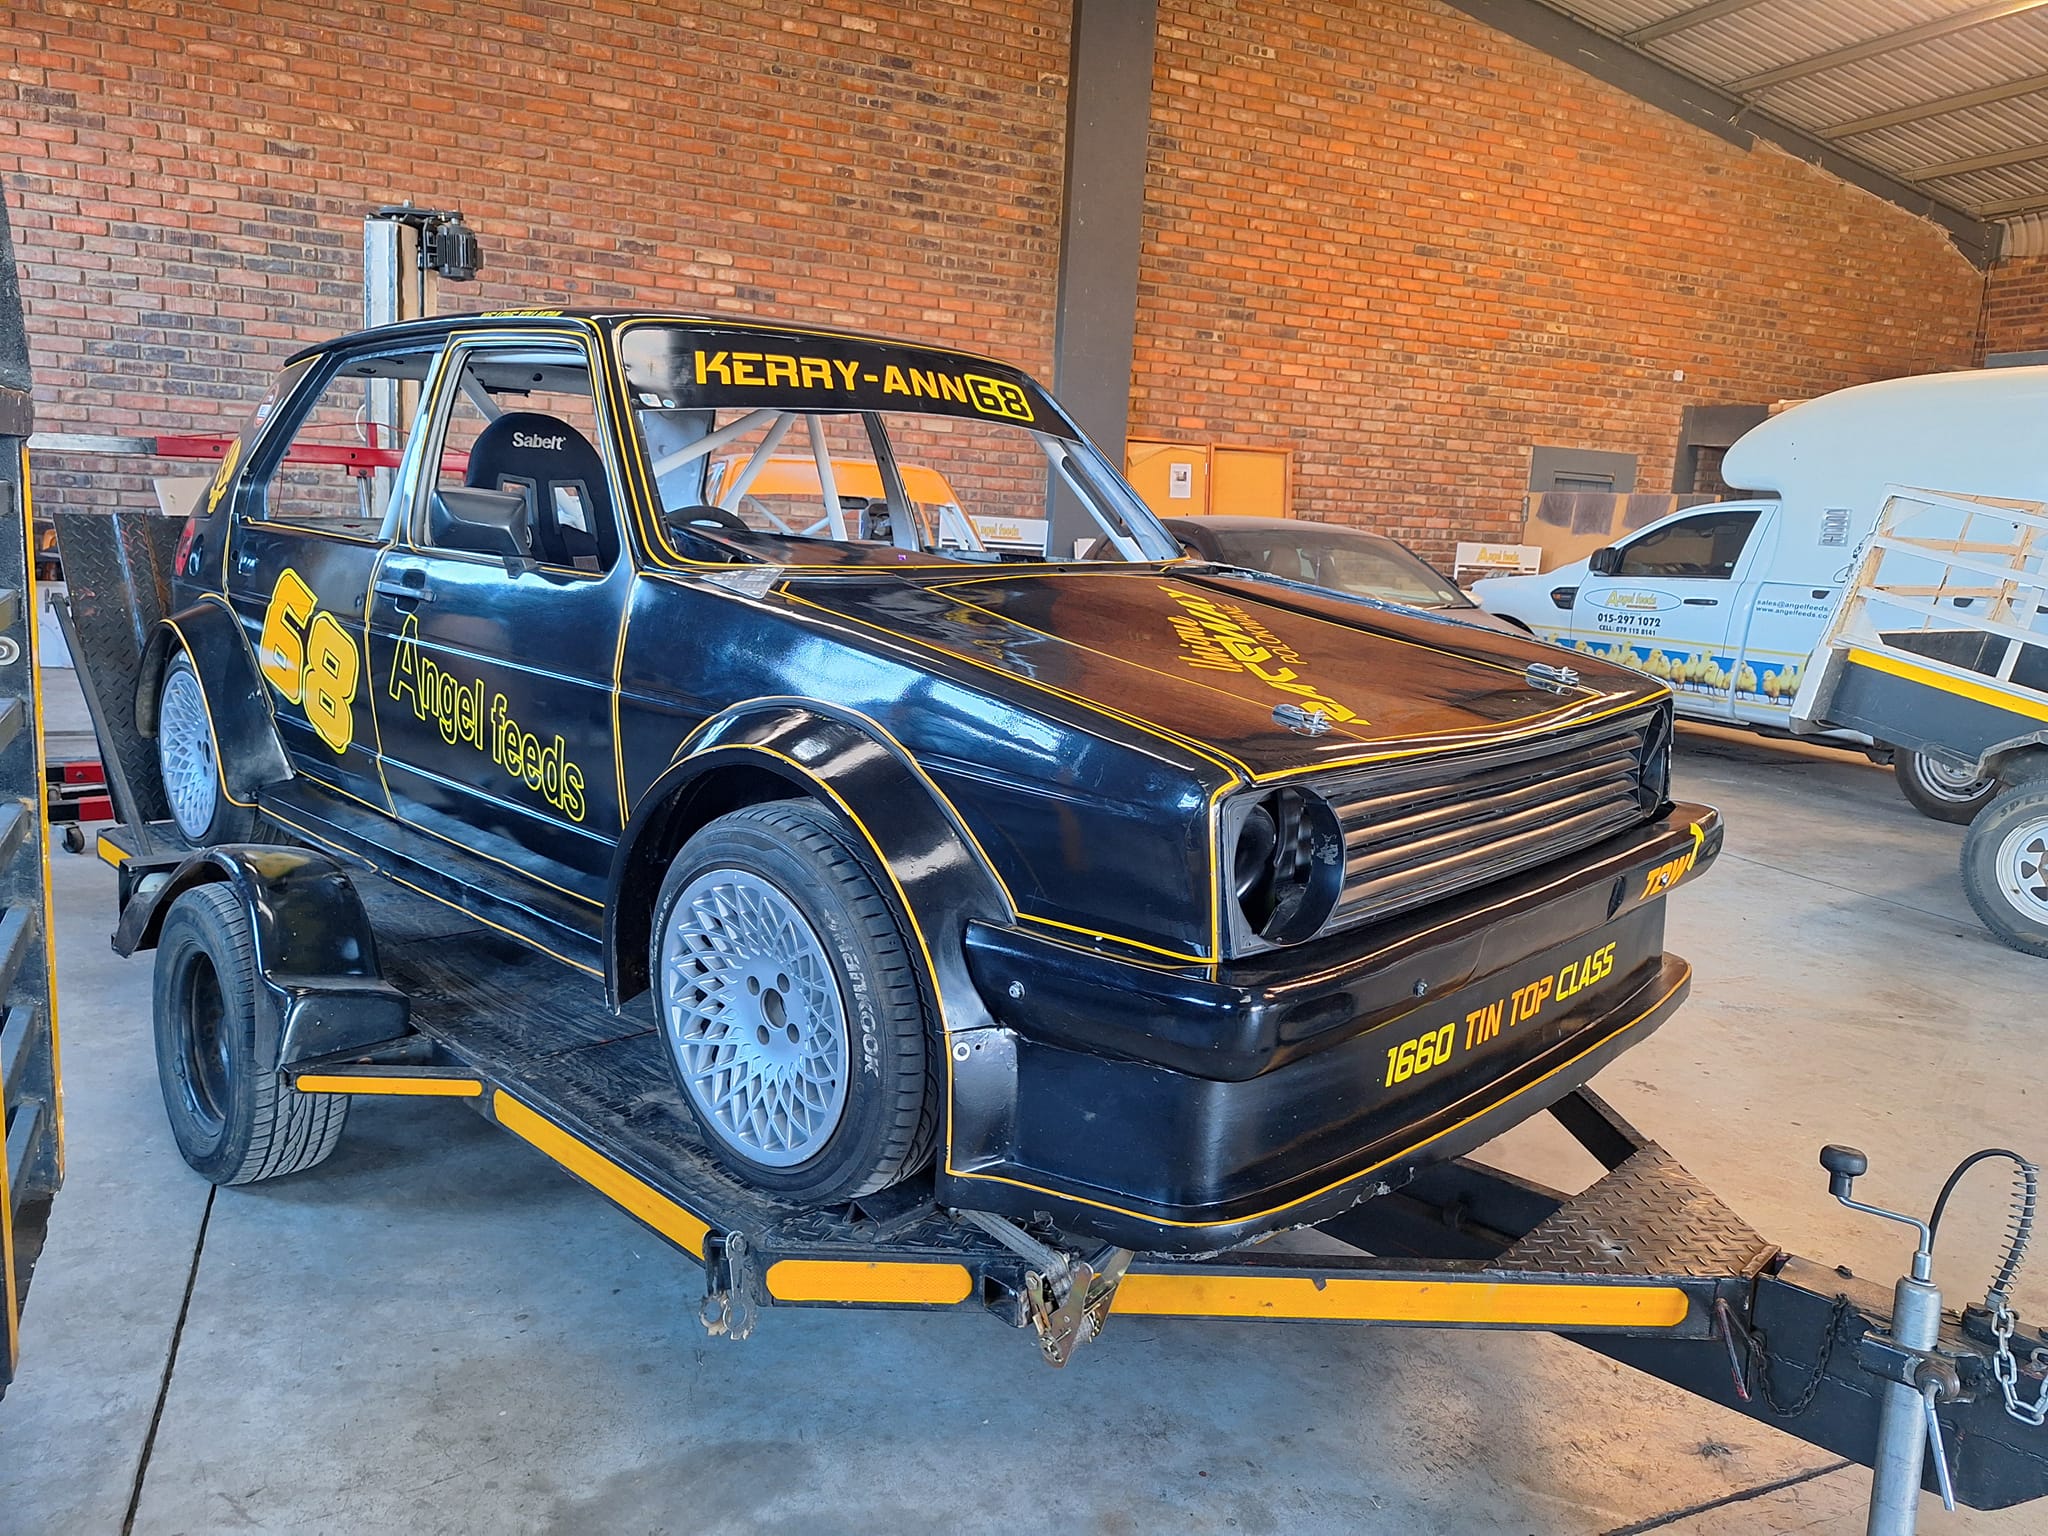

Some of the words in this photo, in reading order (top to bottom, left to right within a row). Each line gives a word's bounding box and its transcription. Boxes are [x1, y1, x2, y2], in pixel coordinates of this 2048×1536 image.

[694, 350, 968, 403] KERRY-ANN
[965, 373, 1034, 421] 68
[512, 431, 564, 450] Sabelt
[1597, 612, 1635, 625] 015-297
[1638, 616, 1661, 627] 1072
[1605, 590, 1635, 607] Angel
[1635, 593, 1657, 606] feeds
[259, 567, 360, 754] 68
[389, 613, 484, 751] Angel
[491, 693, 585, 822] feeds
[1385, 1022, 1456, 1088] 1660
[1464, 999, 1504, 1050] TIN
[1510, 975, 1553, 1026] TOP
[1556, 941, 1617, 1002] CLASS
